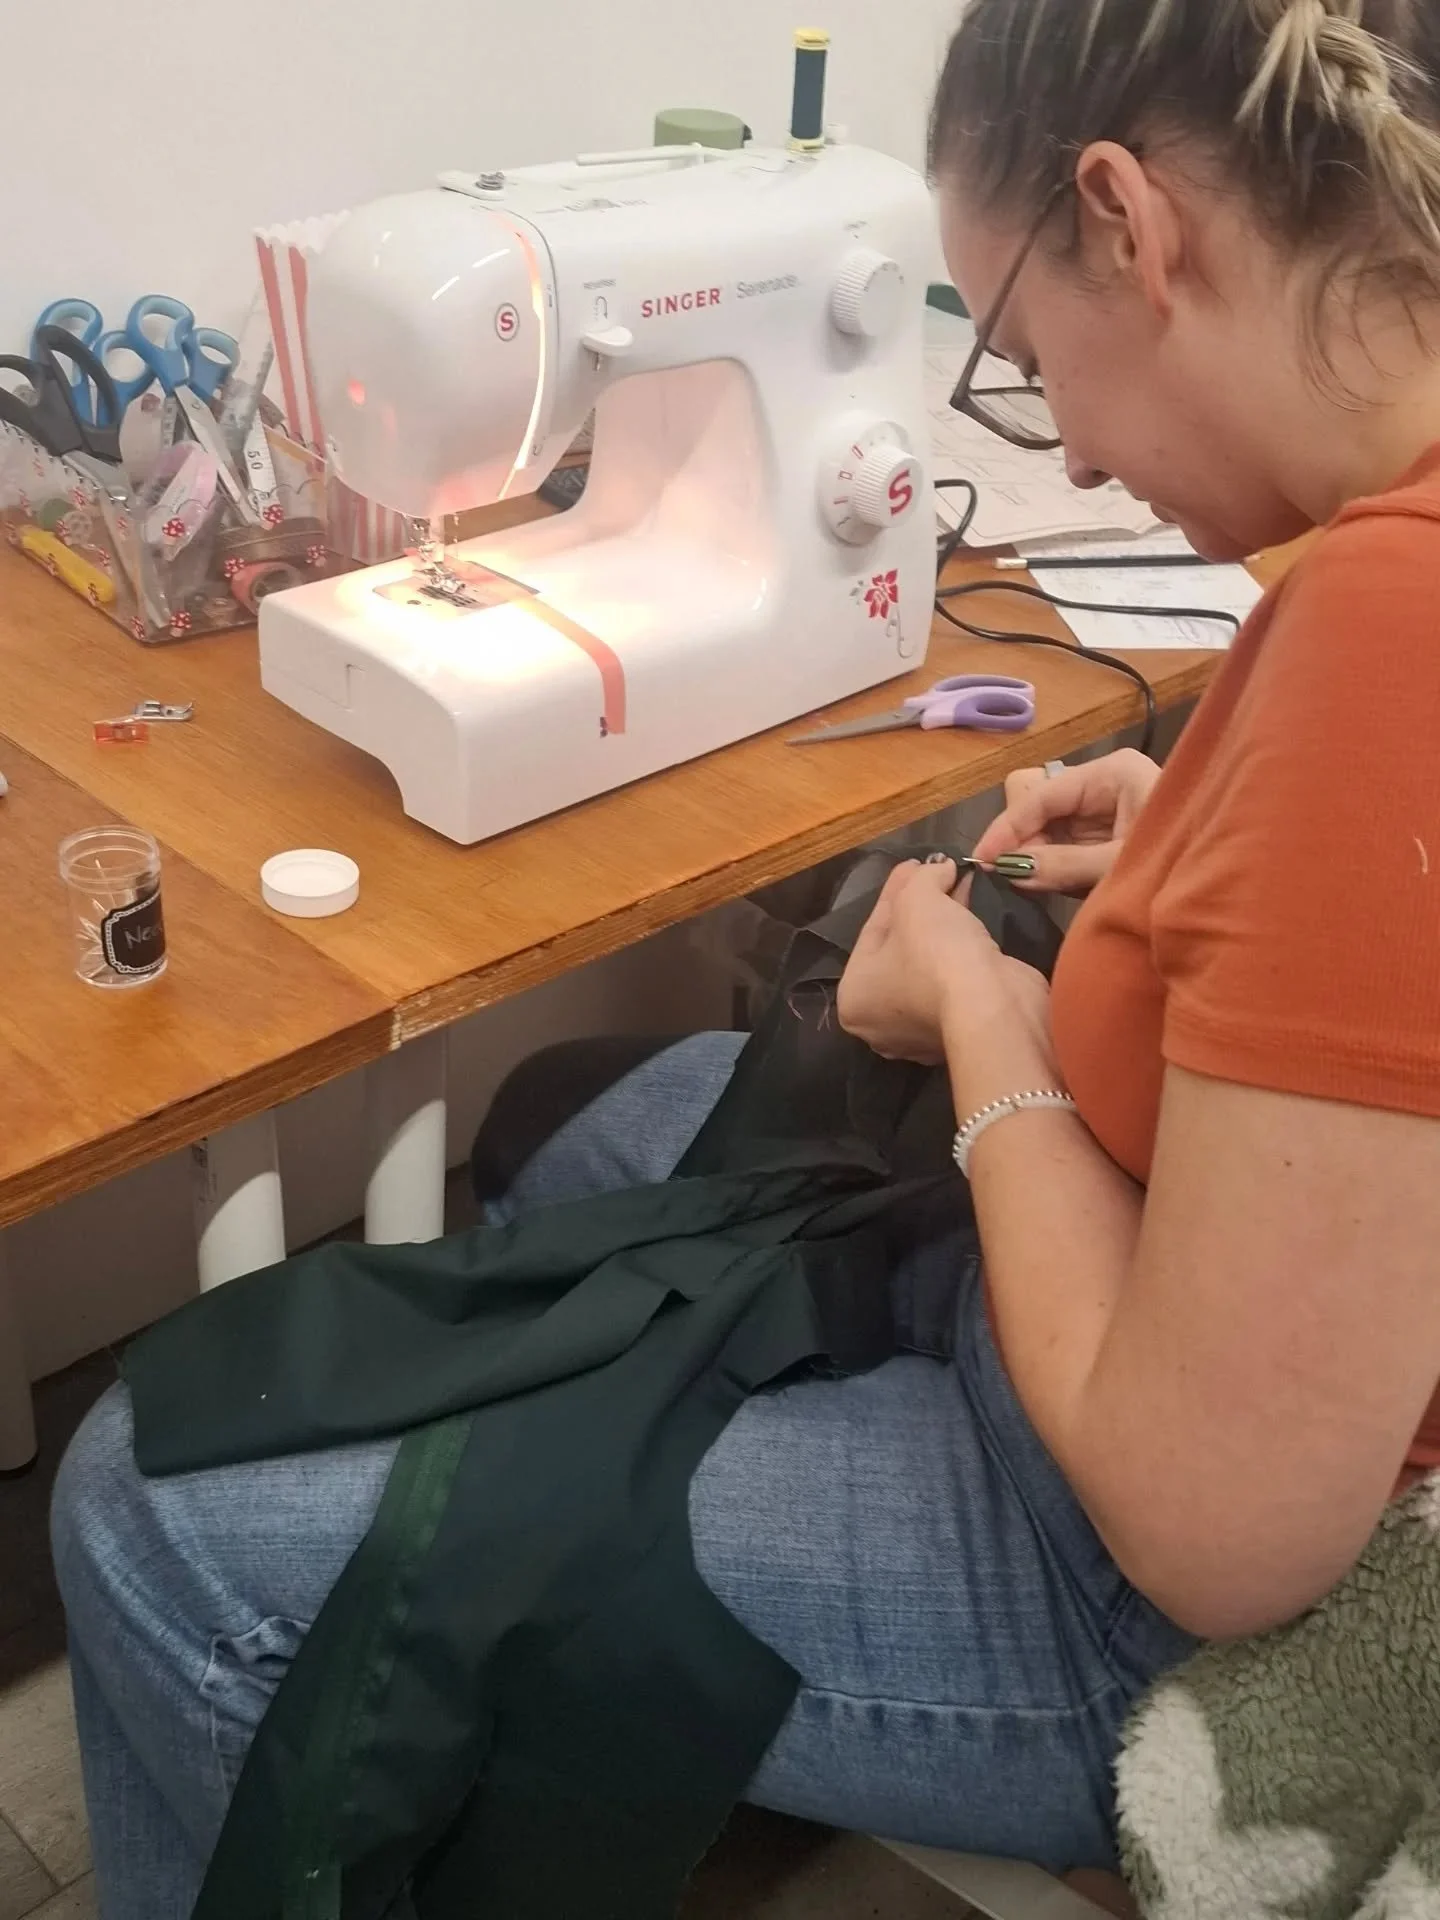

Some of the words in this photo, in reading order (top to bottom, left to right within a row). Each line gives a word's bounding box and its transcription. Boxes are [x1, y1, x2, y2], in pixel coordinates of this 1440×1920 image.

[641, 287, 722, 319] SINGER
[500, 311, 514, 332] S
[247, 450, 264, 470] 50
[888, 468, 914, 516] S
